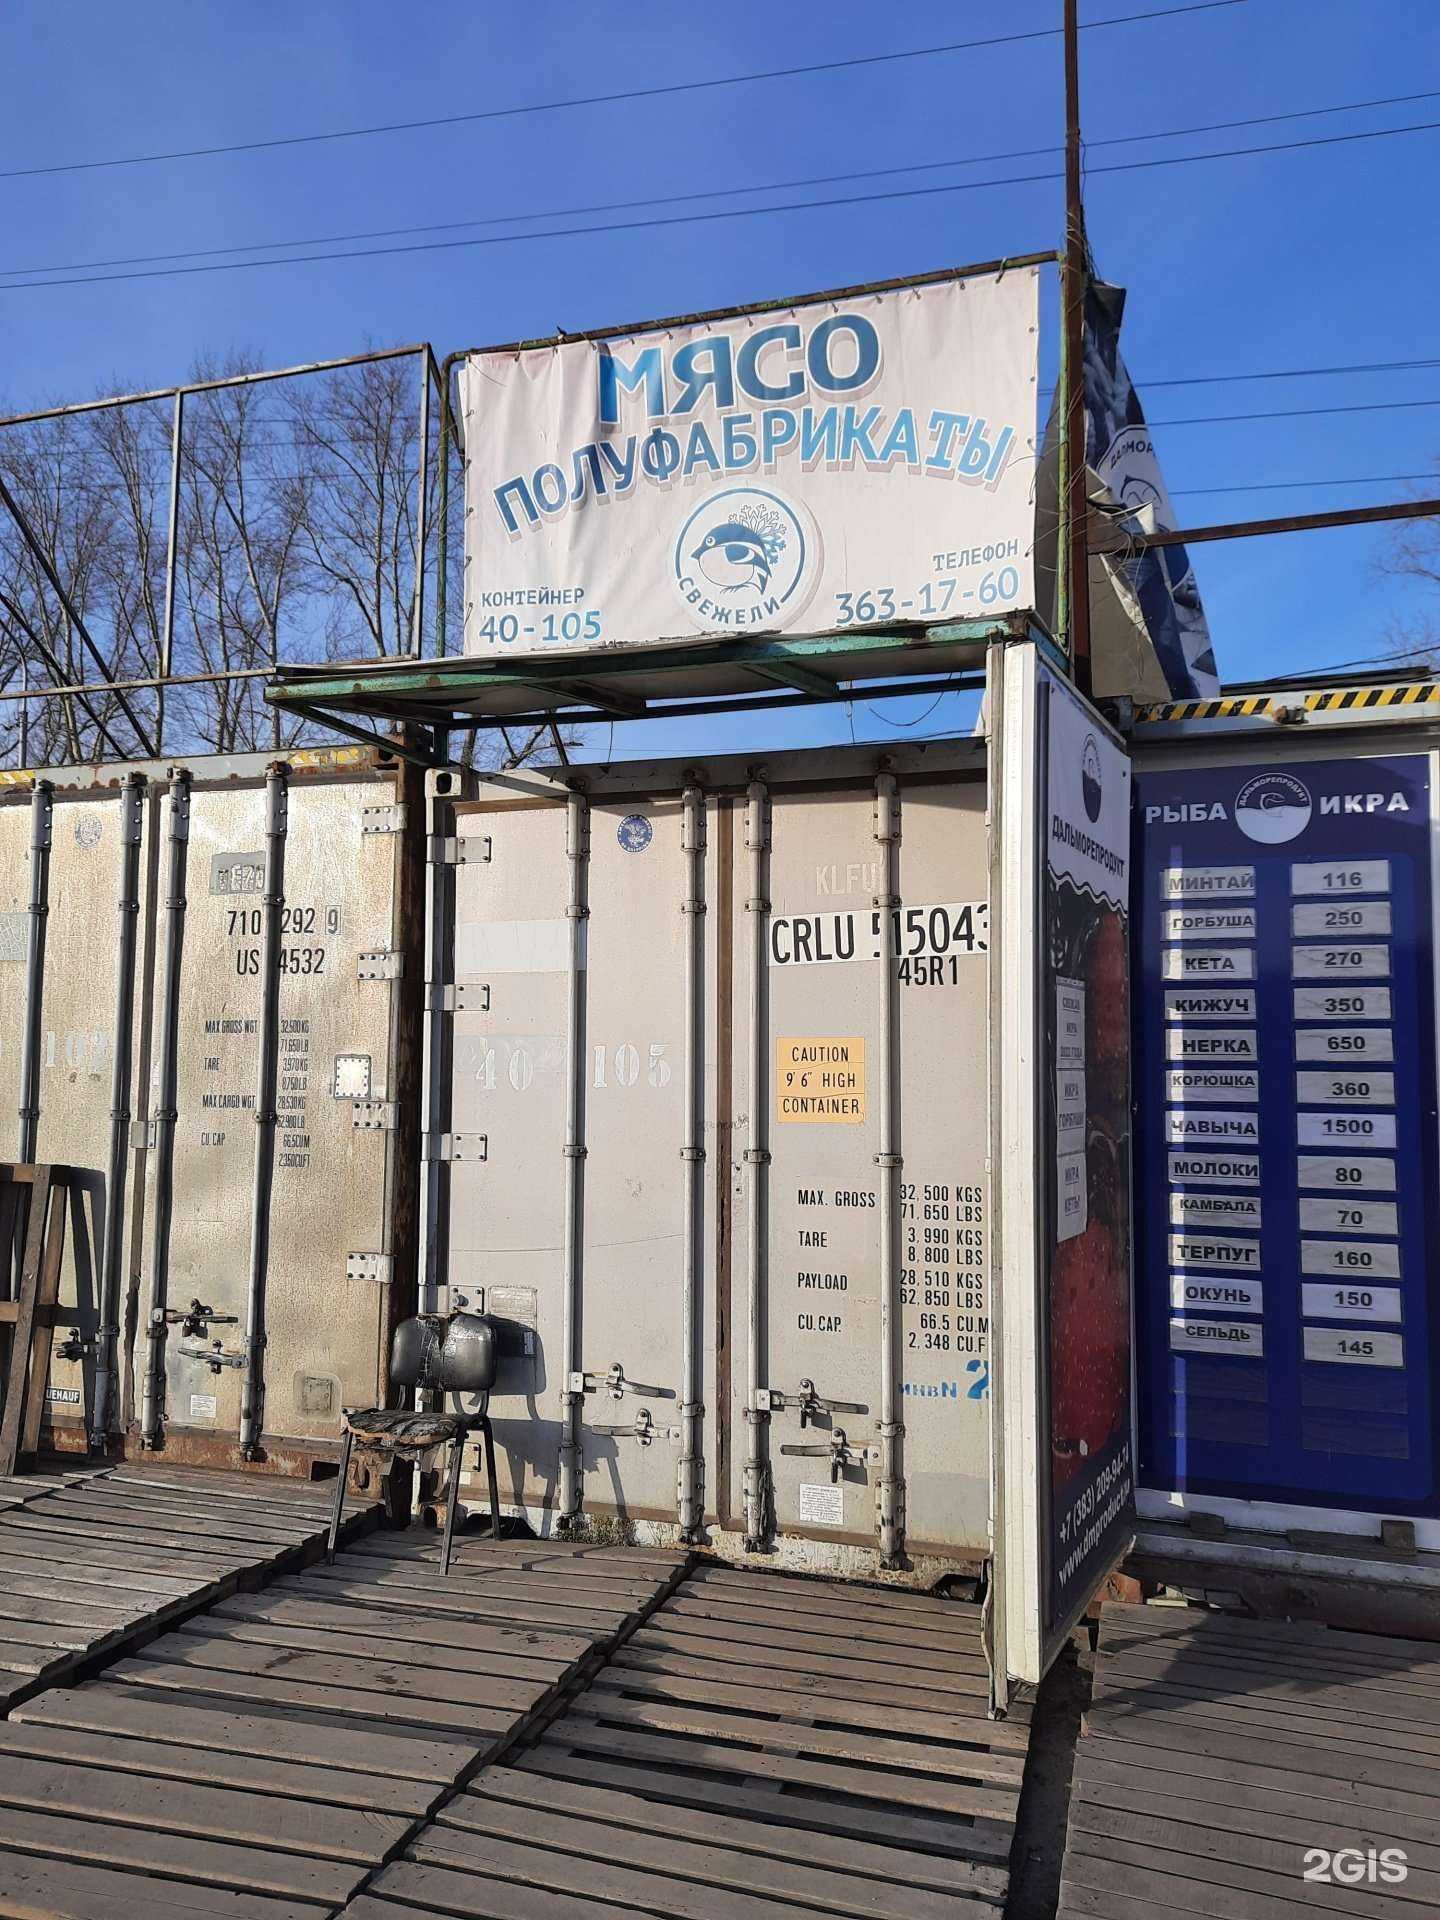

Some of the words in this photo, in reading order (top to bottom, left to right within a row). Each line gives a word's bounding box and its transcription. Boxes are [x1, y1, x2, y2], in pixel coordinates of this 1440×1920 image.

[599, 315, 880, 423] МЯСО
[494, 407, 1013, 535] ПОЛУФАБРИКАТЫ
[933, 539, 1020, 572] ТЕЛЕФОН
[481, 587, 584, 607] КОНТЕЙНЕР
[679, 577, 781, 624] СВЕЖЕЛИ
[836, 567, 1020, 625] 363-17-60
[480, 611, 601, 644] 40-105
[1320, 792, 1410, 815] ИКРА
[1146, 803, 1228, 824] РЫБА
[1052, 814, 1126, 878] ДАЛЬМОРЕПРОДУКТ
[1169, 872, 1255, 891] МИНТАЙ
[1323, 872, 1363, 888] 116
[228, 910, 261, 935] 710
[279, 908, 315, 934] 292
[327, 908, 338, 934] 9
[1173, 915, 1254, 929] ГОРБУША
[1325, 911, 1363, 926] 250
[772, 914, 855, 964] CRLU
[236, 949, 260, 975] US
[278, 948, 325, 974] 4532
[1185, 957, 1235, 970] КЕТА
[1325, 952, 1363, 966] 270
[898, 955, 958, 985] 45R1
[1175, 999, 1249, 1012] КИЖУЧ
[1325, 998, 1365, 1012] 350
[205, 1020, 220, 1033] MAX
[222, 1020, 243, 1033] GROSS
[1183, 1039, 1252, 1053] НЕРКА
[1328, 1036, 1366, 1050] 650
[792, 1046, 849, 1062] CAUTION
[204, 1058, 220, 1071] TARE
[592, 1043, 672, 1089] 105
[822, 1072, 855, 1087] HIGH
[1172, 1075, 1256, 1086] КОРЮШКА
[1332, 1082, 1370, 1096] 360
[202, 1095, 217, 1108] MAX
[218, 1095, 241, 1108] CARGO
[242, 1095, 257, 1108] WGT
[783, 1098, 859, 1114] CONTAINER
[1171, 1120, 1257, 1135] ЧАВЫЧА
[1324, 1119, 1374, 1134] 1500
[1174, 1161, 1259, 1177] МОЛОКИ
[1335, 1168, 1363, 1183] 80
[798, 1189, 828, 1207] MAX.
[834, 1191, 876, 1208] GROSS
[956, 1186, 983, 1203] KGS
[1180, 1199, 1257, 1213] КАМБАЛА
[956, 1206, 983, 1223] LBS
[1338, 1210, 1364, 1225] 70
[798, 1230, 828, 1248] TARE
[956, 1229, 983, 1247] KGS
[956, 1248, 983, 1266] LBS
[1177, 1244, 1257, 1262] ТЕРПУГ
[1334, 1251, 1373, 1267] 160
[798, 1272, 848, 1291] PAYLOAD
[956, 1272, 983, 1289] KGS
[956, 1291, 983, 1309] LBS
[1185, 1286, 1252, 1303] ОКУНЬ
[1334, 1291, 1373, 1307] 150
[920, 1313, 950, 1331] 66.5
[1186, 1325, 1251, 1340] СЕЛЬДЬ
[957, 1335, 988, 1353] CU.F
[1338, 1340, 1374, 1355] 145
[46, 1388, 80, 1402] UEHAUF
[1073, 1483, 1095, 1537] (383)
